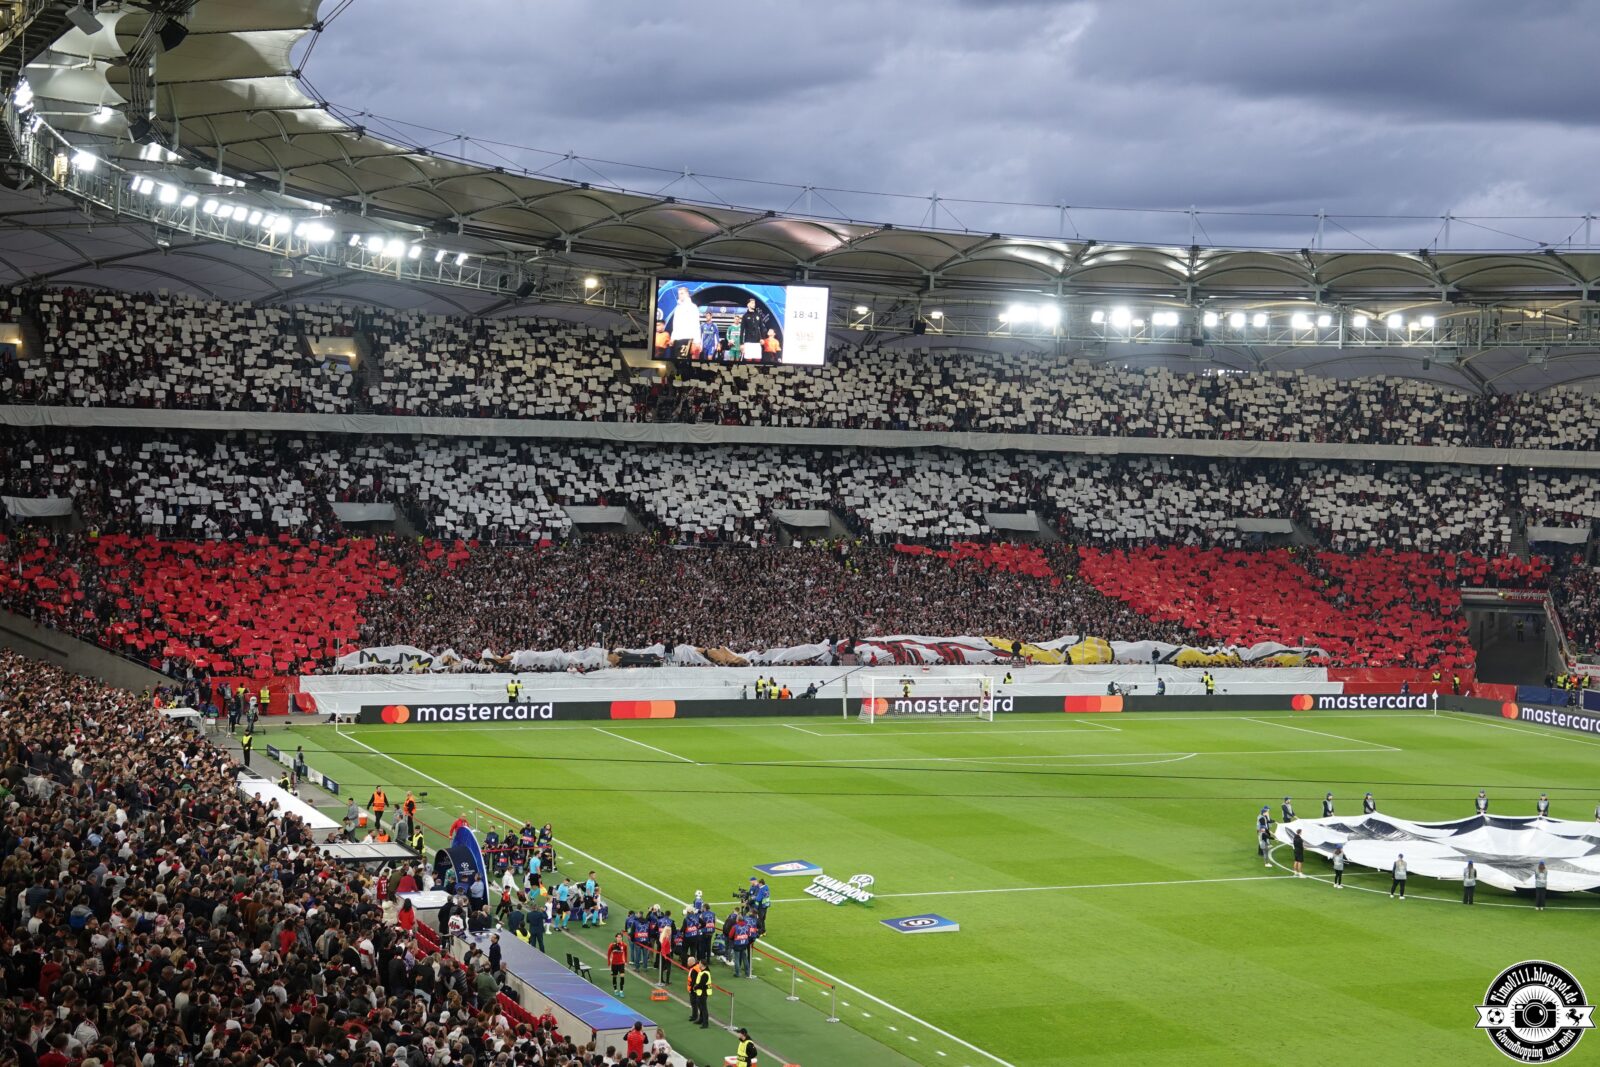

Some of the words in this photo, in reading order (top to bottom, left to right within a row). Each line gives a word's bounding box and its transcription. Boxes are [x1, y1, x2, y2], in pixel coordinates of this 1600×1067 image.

[895, 696, 1014, 713] mastercard
[1319, 693, 1427, 710] mastercard
[416, 702, 553, 721] mastercard
[803, 883, 848, 905] LEAGUE
[813, 874, 874, 902] CHAMPIONS
